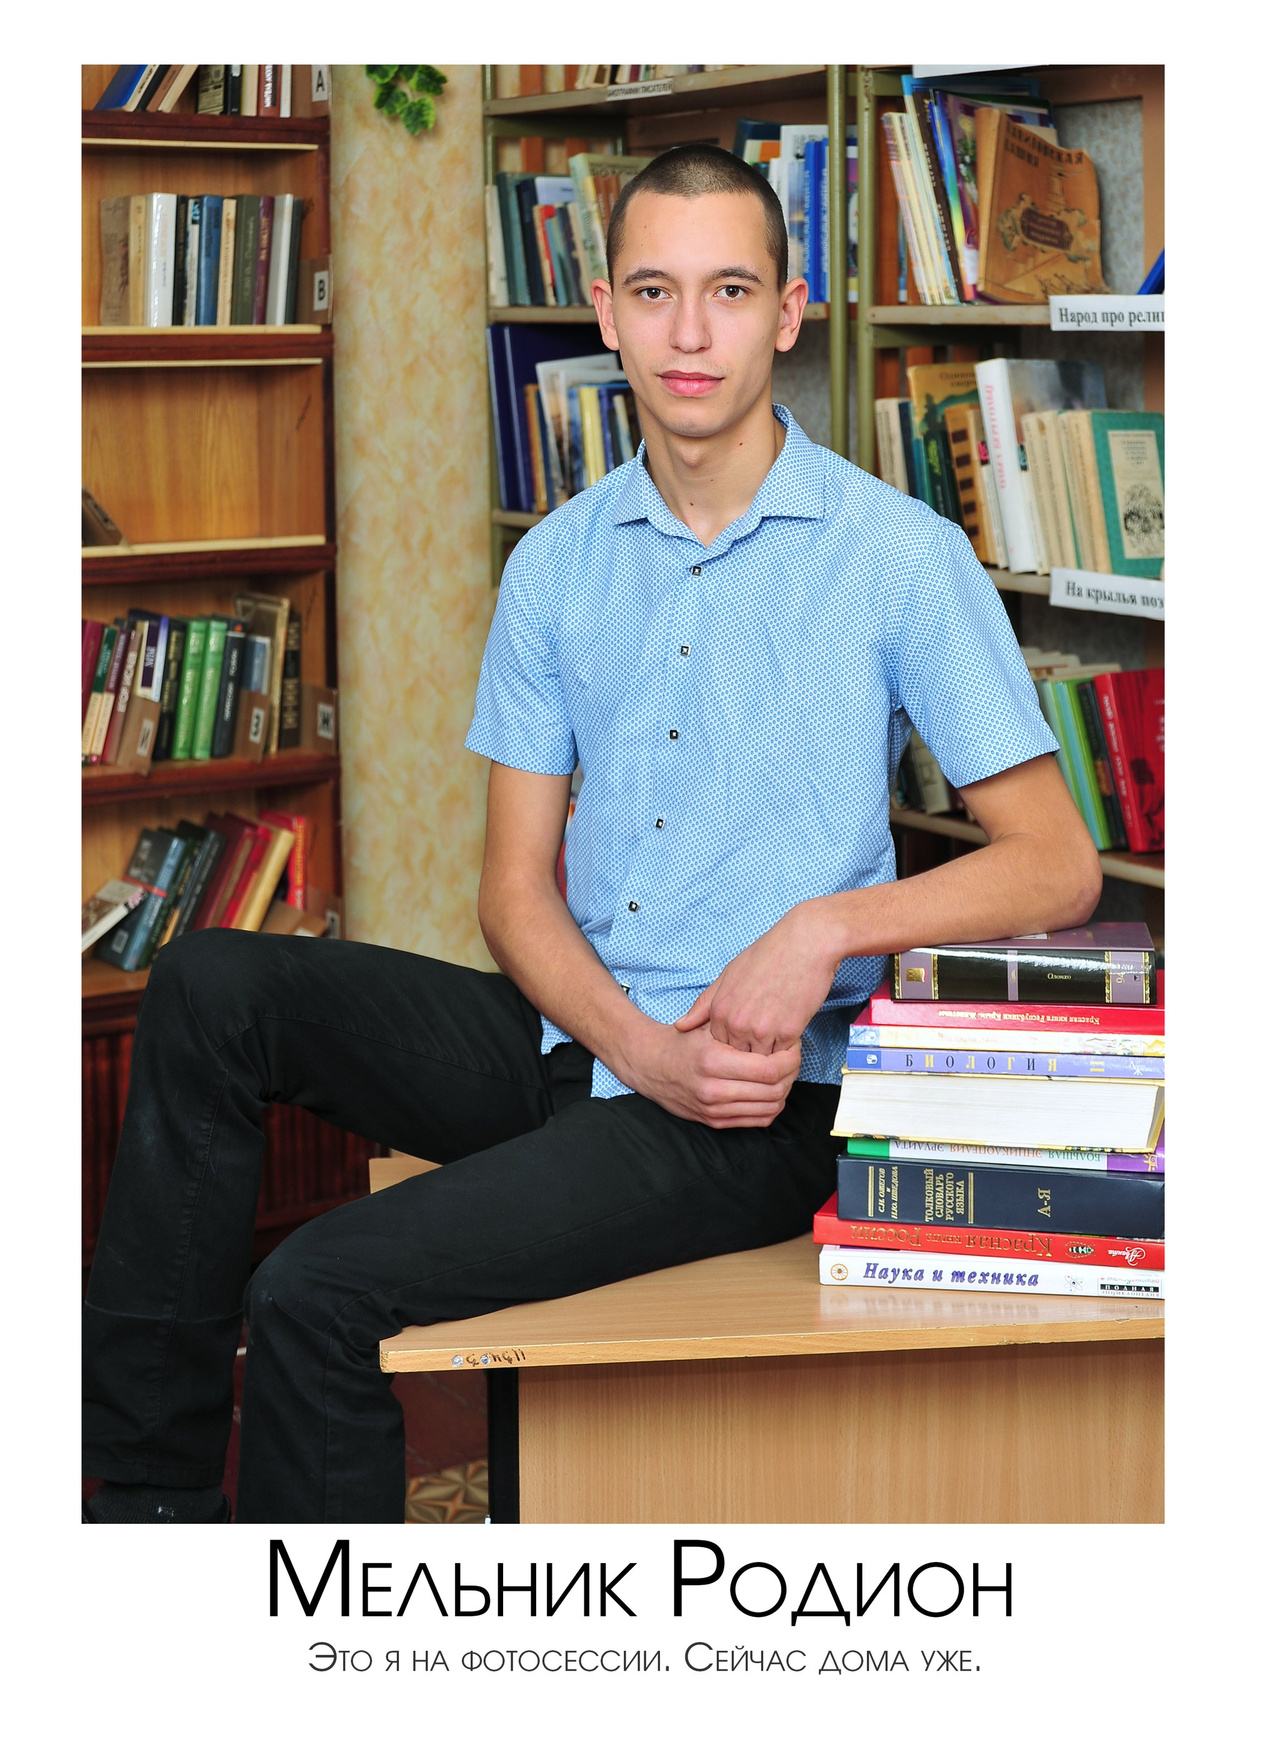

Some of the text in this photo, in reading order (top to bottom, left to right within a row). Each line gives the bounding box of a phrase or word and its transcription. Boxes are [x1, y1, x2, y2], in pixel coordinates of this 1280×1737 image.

[1058, 307, 1098, 327] Народ
[1101, 311, 1125, 327] про
[1066, 581, 1083, 598] На
[1087, 586, 1138, 604] крылья
[905, 1053, 1058, 1073] БИОЛОГИЯ
[924, 1168, 935, 1222] ТОЛКОВЫЙ
[935, 1174, 945, 1218] СЛОВАРЬ
[945, 1172, 955, 1222] РУССКОГО
[956, 1179, 965, 1216] ЯЗЫКА
[850, 1225, 922, 1248] России
[965, 1233, 1054, 1258] Красная
[863, 1261, 1040, 1287] Наука и техника
